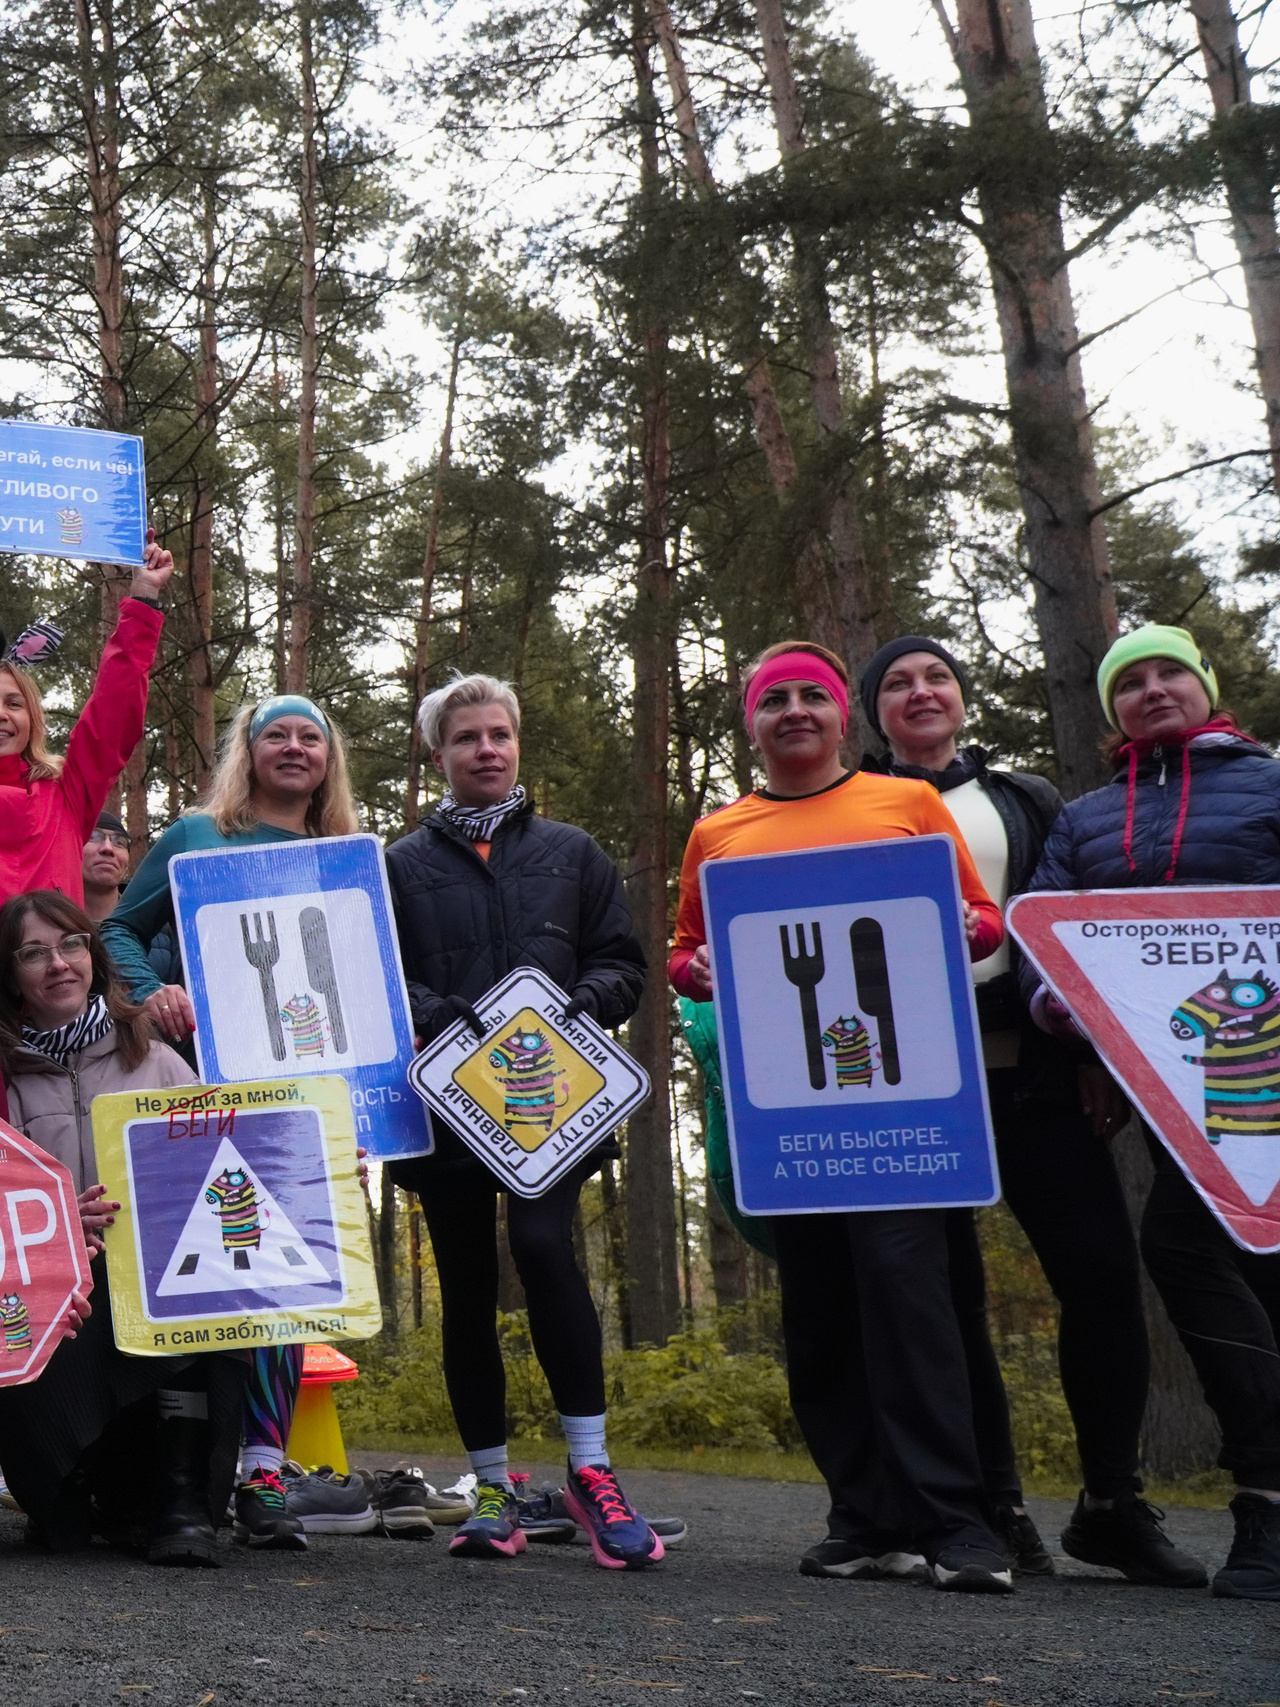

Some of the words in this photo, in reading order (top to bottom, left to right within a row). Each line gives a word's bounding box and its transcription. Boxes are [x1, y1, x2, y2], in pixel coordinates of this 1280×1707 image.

[51, 456, 101, 472] если
[106, 456, 133, 476] чё!
[1081, 920, 1228, 940] Осторожно,
[1140, 941, 1267, 965] ЗЕБРА
[482, 1009, 507, 1034] вы
[542, 1003, 609, 1067] поняли
[135, 1095, 162, 1112] Не
[221, 1093, 243, 1106] за
[247, 1084, 306, 1103] мной,
[168, 1108, 236, 1140] БЕГИ
[580, 1096, 616, 1129] кто
[439, 1082, 529, 1172] Главный
[551, 1125, 584, 1156] тут
[778, 1131, 834, 1154] БЕГИ
[773, 1161, 788, 1179] А
[792, 1159, 819, 1178] ТО
[826, 1157, 866, 1176] ВСЕ
[872, 1151, 962, 1176] СЪЕДЯТ
[153, 1333, 166, 1346] я
[171, 1329, 210, 1345] сам
[215, 1315, 348, 1341] заблудился!
